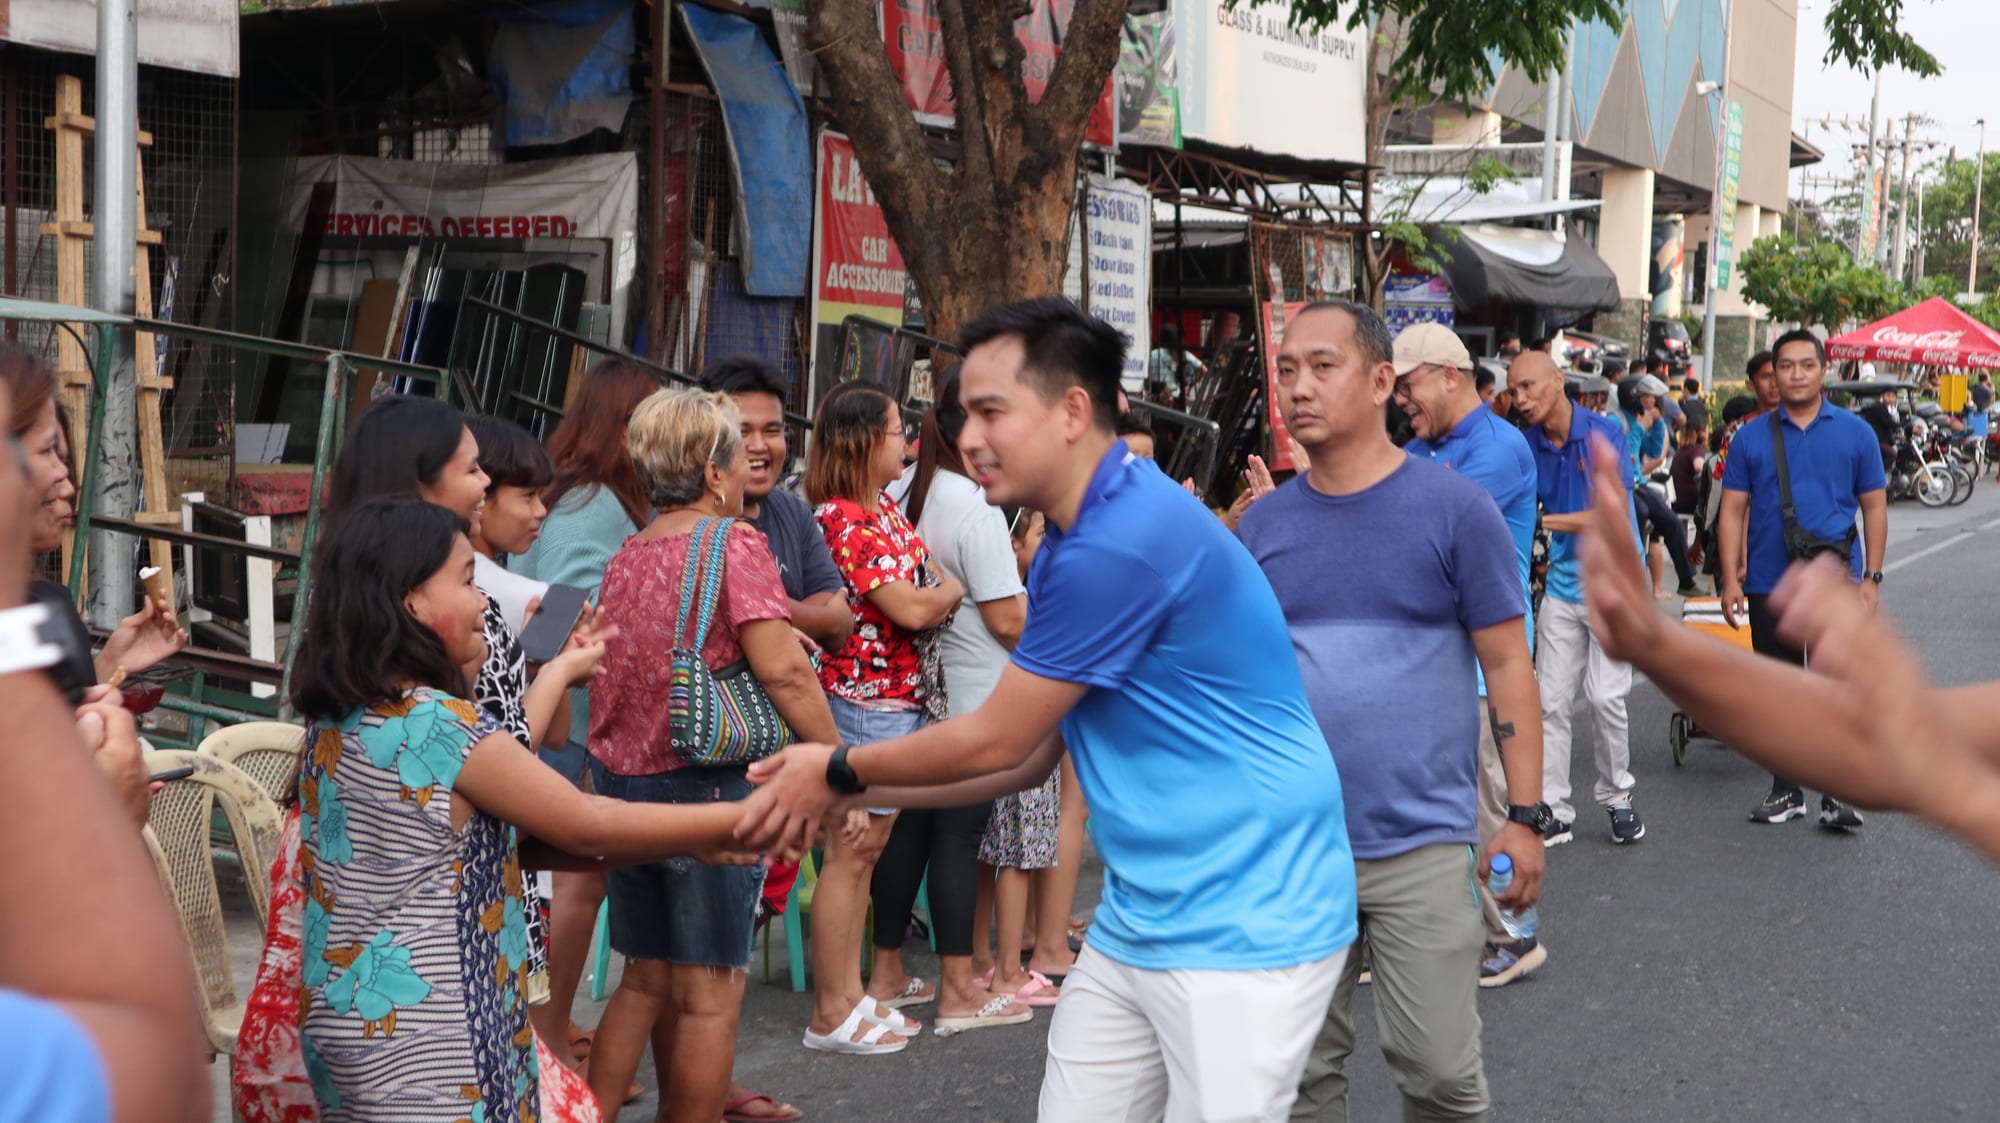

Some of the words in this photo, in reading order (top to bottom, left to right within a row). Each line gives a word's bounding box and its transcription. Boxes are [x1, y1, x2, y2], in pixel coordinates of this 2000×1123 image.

[1217, 5, 1252, 33] GLASS
[1255, 15, 1263, 36] &
[1322, 34, 1356, 61] SUPPLY
[324, 213, 436, 237] ERVICES
[1087, 193, 1140, 225] ESSORIES
[861, 235, 888, 263] CAR
[826, 261, 905, 294] ACCESSORIES
